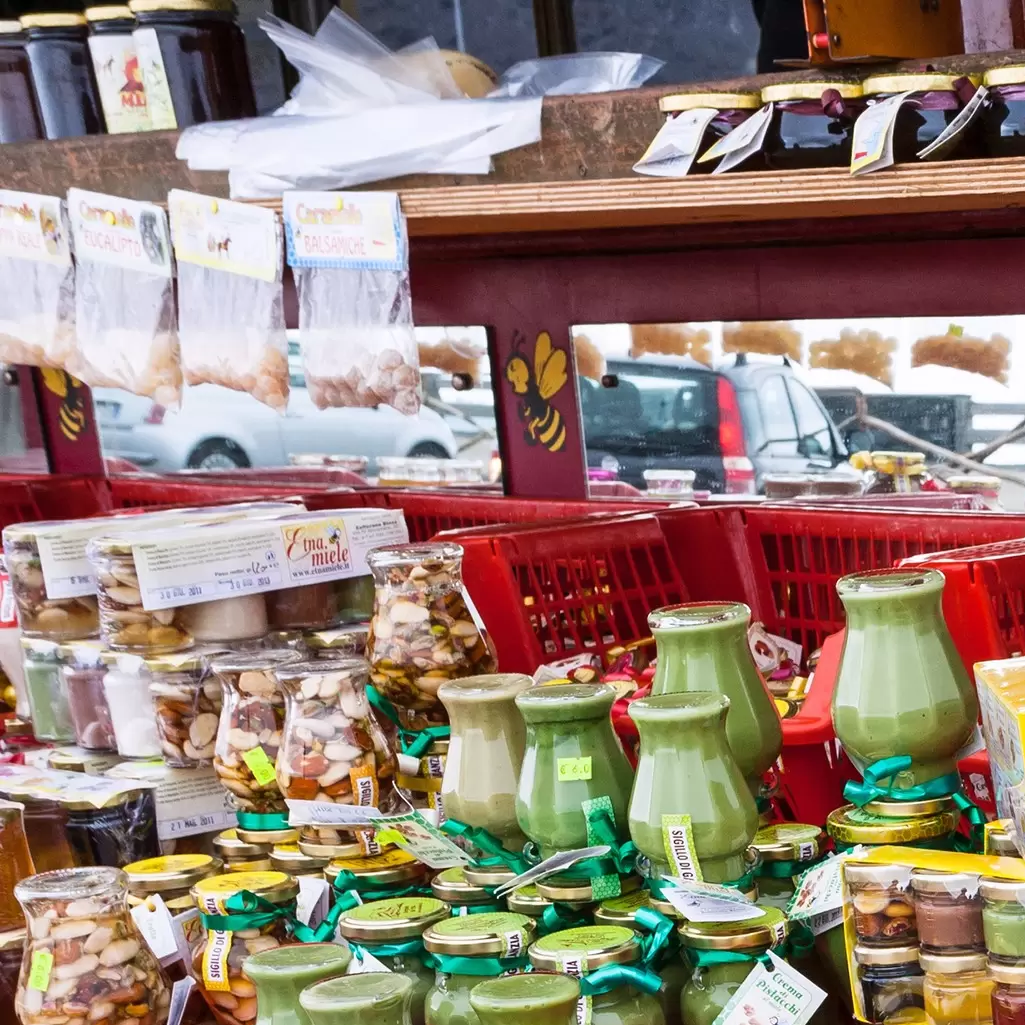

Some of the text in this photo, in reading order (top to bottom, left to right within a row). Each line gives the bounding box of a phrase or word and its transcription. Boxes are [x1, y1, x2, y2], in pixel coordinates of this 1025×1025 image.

[304, 235, 367, 256] BALSAMICHE
[311, 538, 348, 567] miele
[199, 816, 215, 826] 2011
[671, 829, 690, 870] SIGILLO DI
[210, 935, 225, 979] SIGILLO DI
[755, 979, 801, 1017] Pistacchi
[772, 972, 804, 1000] Crema
